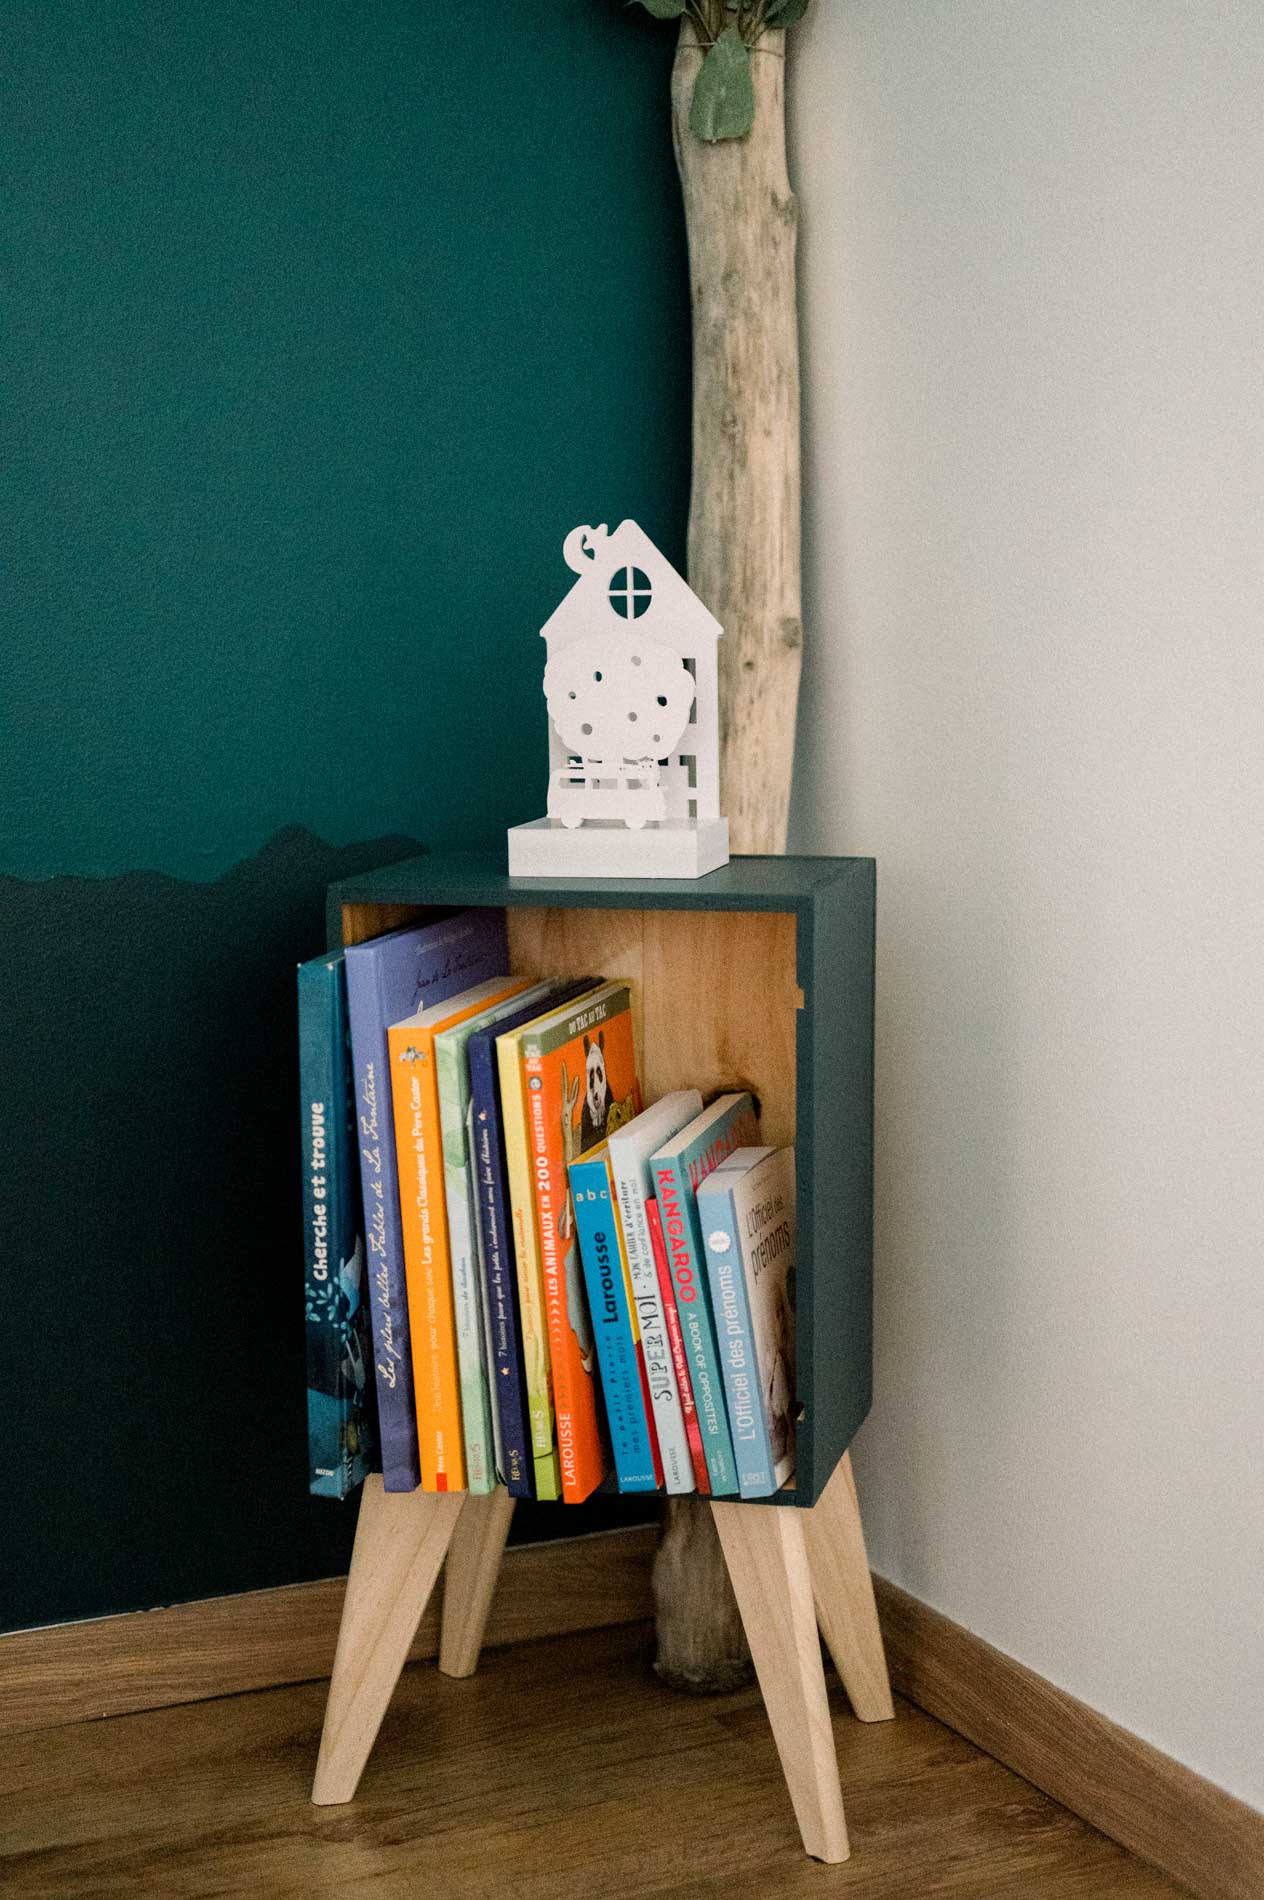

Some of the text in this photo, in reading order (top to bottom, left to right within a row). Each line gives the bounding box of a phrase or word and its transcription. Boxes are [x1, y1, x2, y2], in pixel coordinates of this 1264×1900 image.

[575, 1013, 589, 1031] TAC
[594, 1003, 607, 1021] TAC
[410, 1076, 421, 1110] Castor
[413, 1137, 424, 1152] du
[311, 1102, 328, 1280] Cherche et trouve
[416, 1153, 428, 1207] Classiques
[531, 1094, 558, 1295] LES ANIMAUX EN 200 QUESTIONS
[360, 1062, 401, 1388] Les plus belles Fables de La Fontaine
[418, 1208, 434, 1244] grands
[656, 1169, 696, 1303] KANGAROO
[421, 1245, 432, 1264] Les
[626, 1231, 637, 1260] CAHIER
[751, 1220, 791, 1285] prénoms
[496, 1286, 505, 1300] que
[594, 1232, 619, 1323] Larousse
[497, 1302, 507, 1319] pour
[429, 1327, 440, 1349] pour
[499, 1321, 507, 1350] histoires
[616, 1335, 627, 1364] mots
[633, 1292, 673, 1403] SUPER MOI
[717, 1265, 756, 1440] L'Officiel des prénoms
[687, 1312, 719, 1434] A BOOK OF OPPOSITES!
[622, 1370, 639, 1424] premiers
[558, 1413, 576, 1485] LAROUSSE
[671, 1447, 681, 1485] LAROUSSE
[620, 1474, 655, 1483] LAROUSSE
